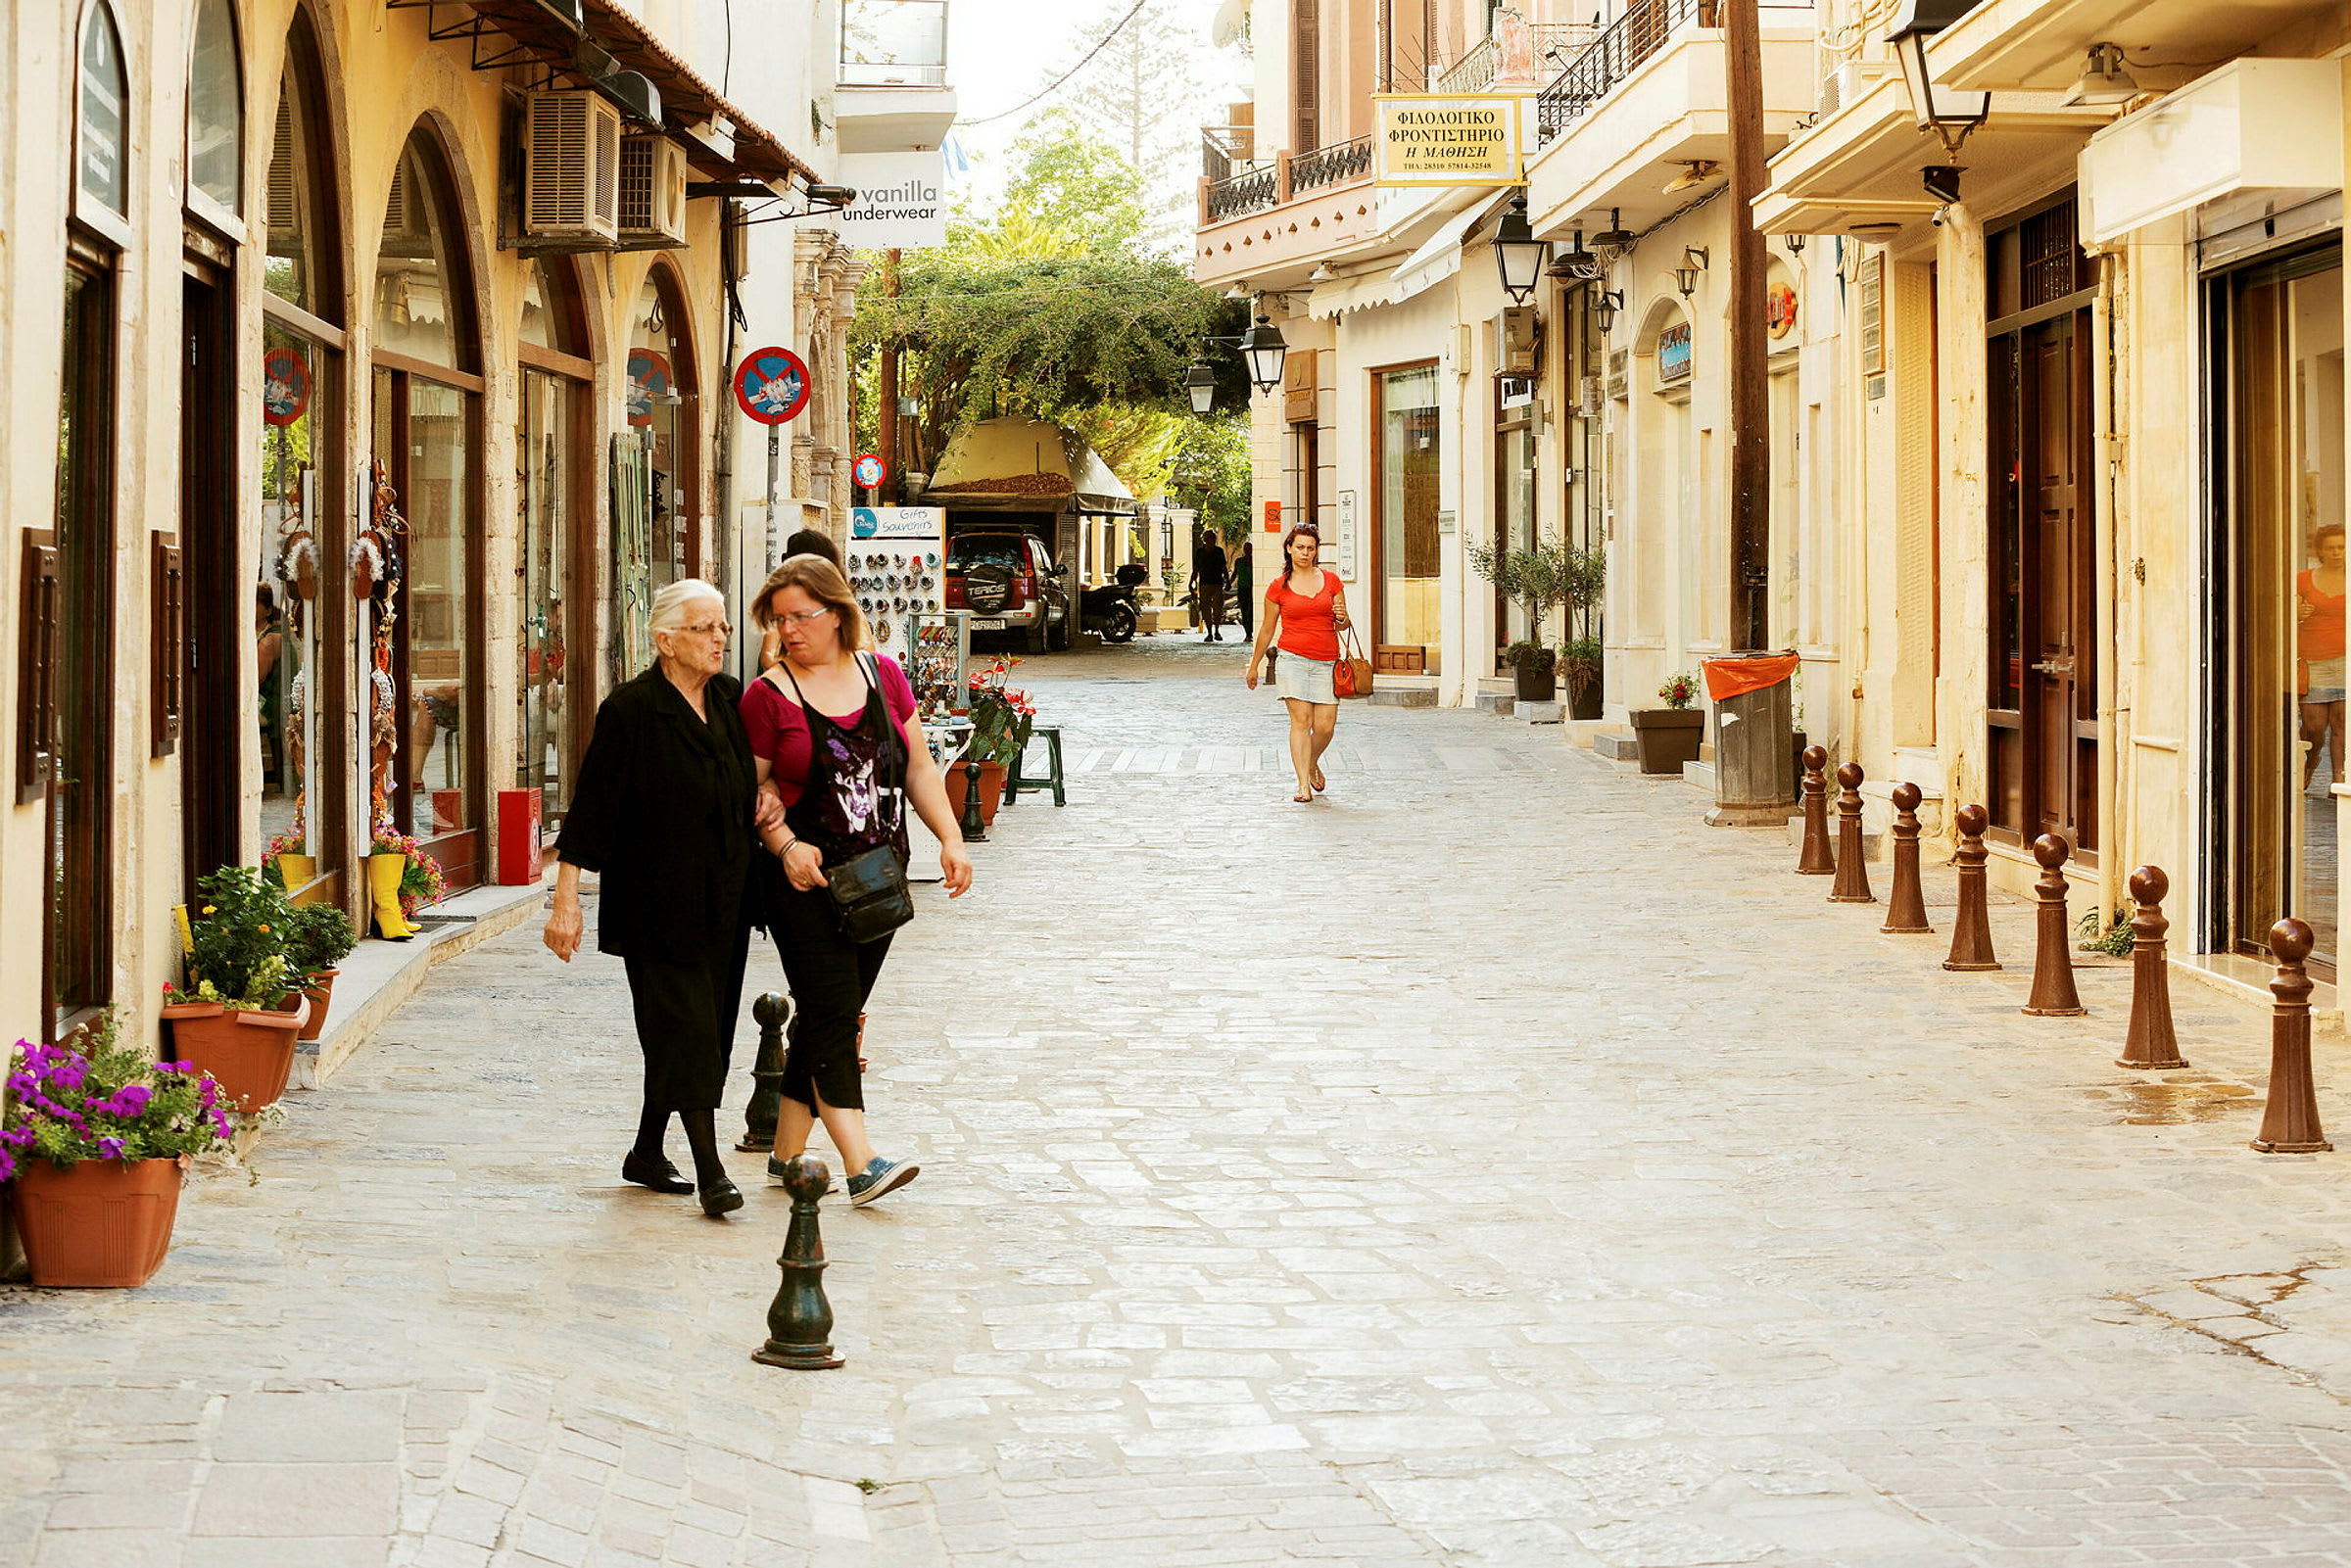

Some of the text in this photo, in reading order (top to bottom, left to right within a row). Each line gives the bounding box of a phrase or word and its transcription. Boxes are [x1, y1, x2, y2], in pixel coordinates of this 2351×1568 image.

[1397, 111, 1495, 124] ΦΙΛΟΛΟΓΙΚΟ
[1388, 128, 1505, 142] ΦΡΟΝΤΙΣΤΗΡΙΟ
[1406, 146, 1488, 158] Η ΜΑΘΗΣΗ
[861, 180, 936, 203] vanilla
[842, 204, 936, 221] underwear
[899, 508, 928, 520] Gifts
[968, 584, 1006, 596] TERIOS
